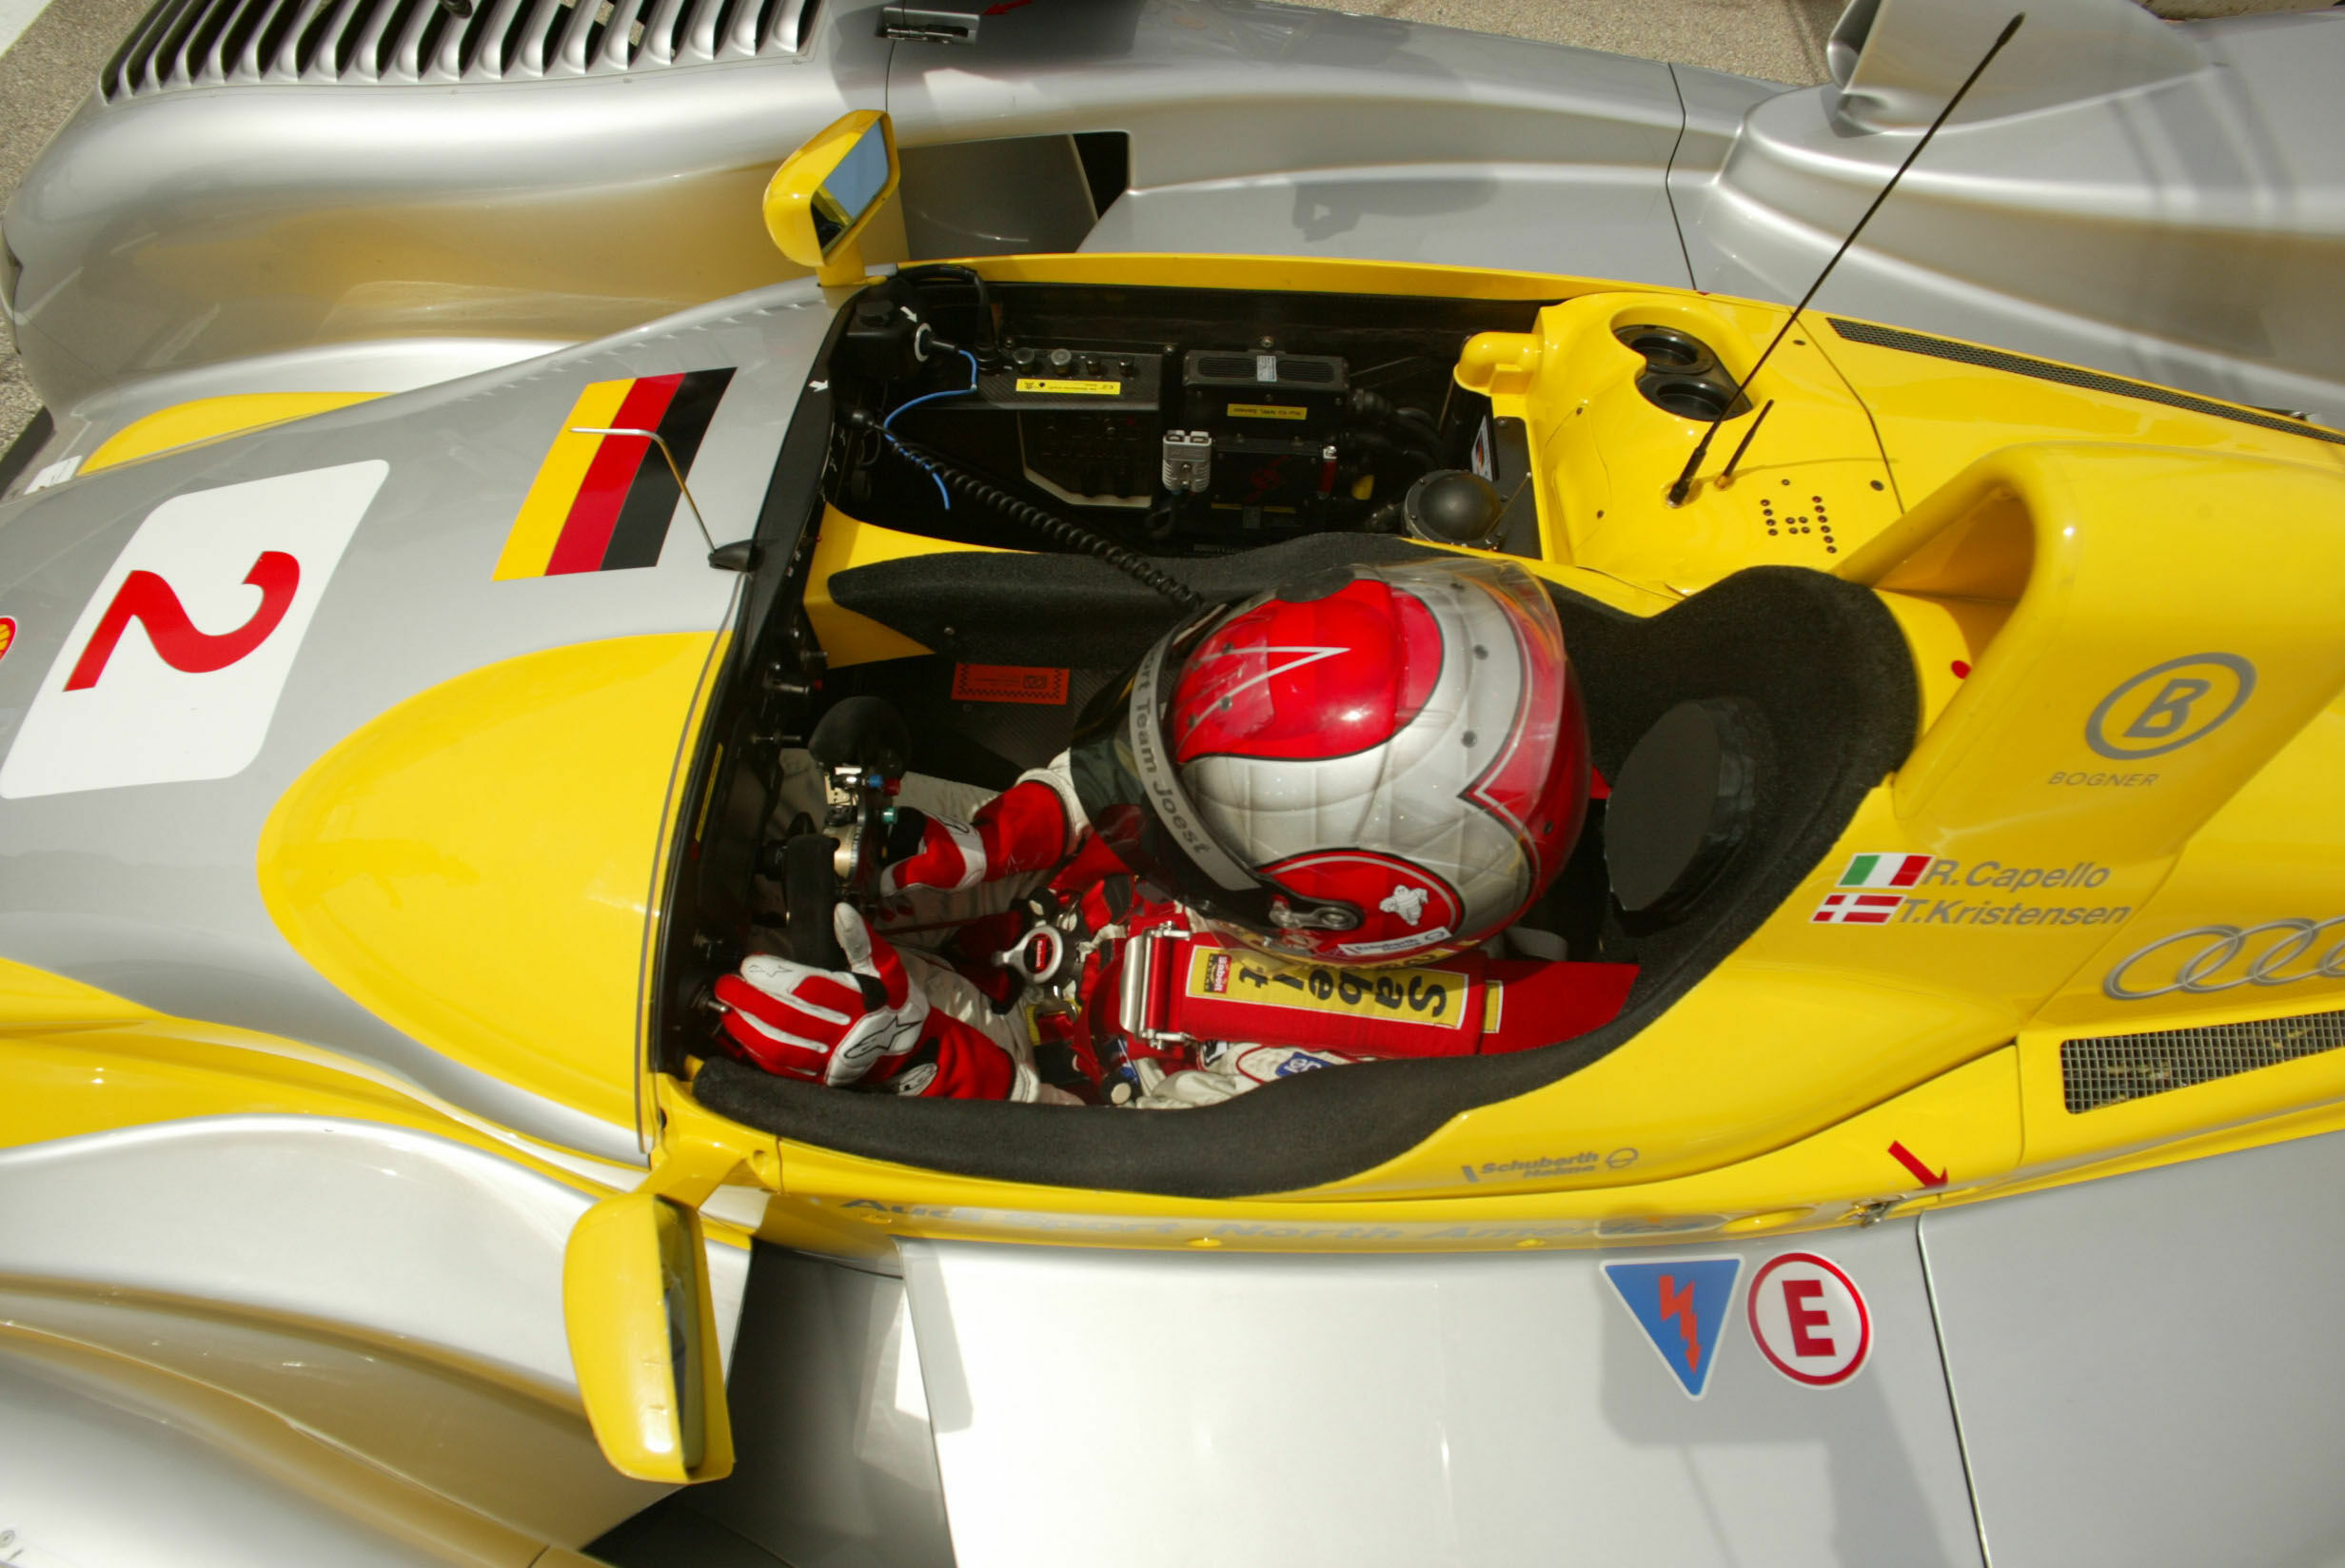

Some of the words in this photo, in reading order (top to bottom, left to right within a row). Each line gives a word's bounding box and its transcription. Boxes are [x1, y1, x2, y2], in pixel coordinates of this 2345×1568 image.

[63, 551, 300, 692] 2
[2122, 677, 2212, 737] B
[1135, 699, 1158, 774] Team
[1153, 778, 1212, 854] Joest
[2048, 771, 2160, 787] BOGNER
[1923, 859, 2111, 892] R.Capello
[1900, 898, 2131, 926] T.Kristensen
[1239, 968, 1447, 1017] Sabelt
[1481, 1151, 1600, 1174] Schuberth
[839, 1199, 983, 1223] Audi
[1005, 1212, 1181, 1233] Sport
[1212, 1223, 1404, 1240] North
[1782, 1280, 1836, 1357] E
